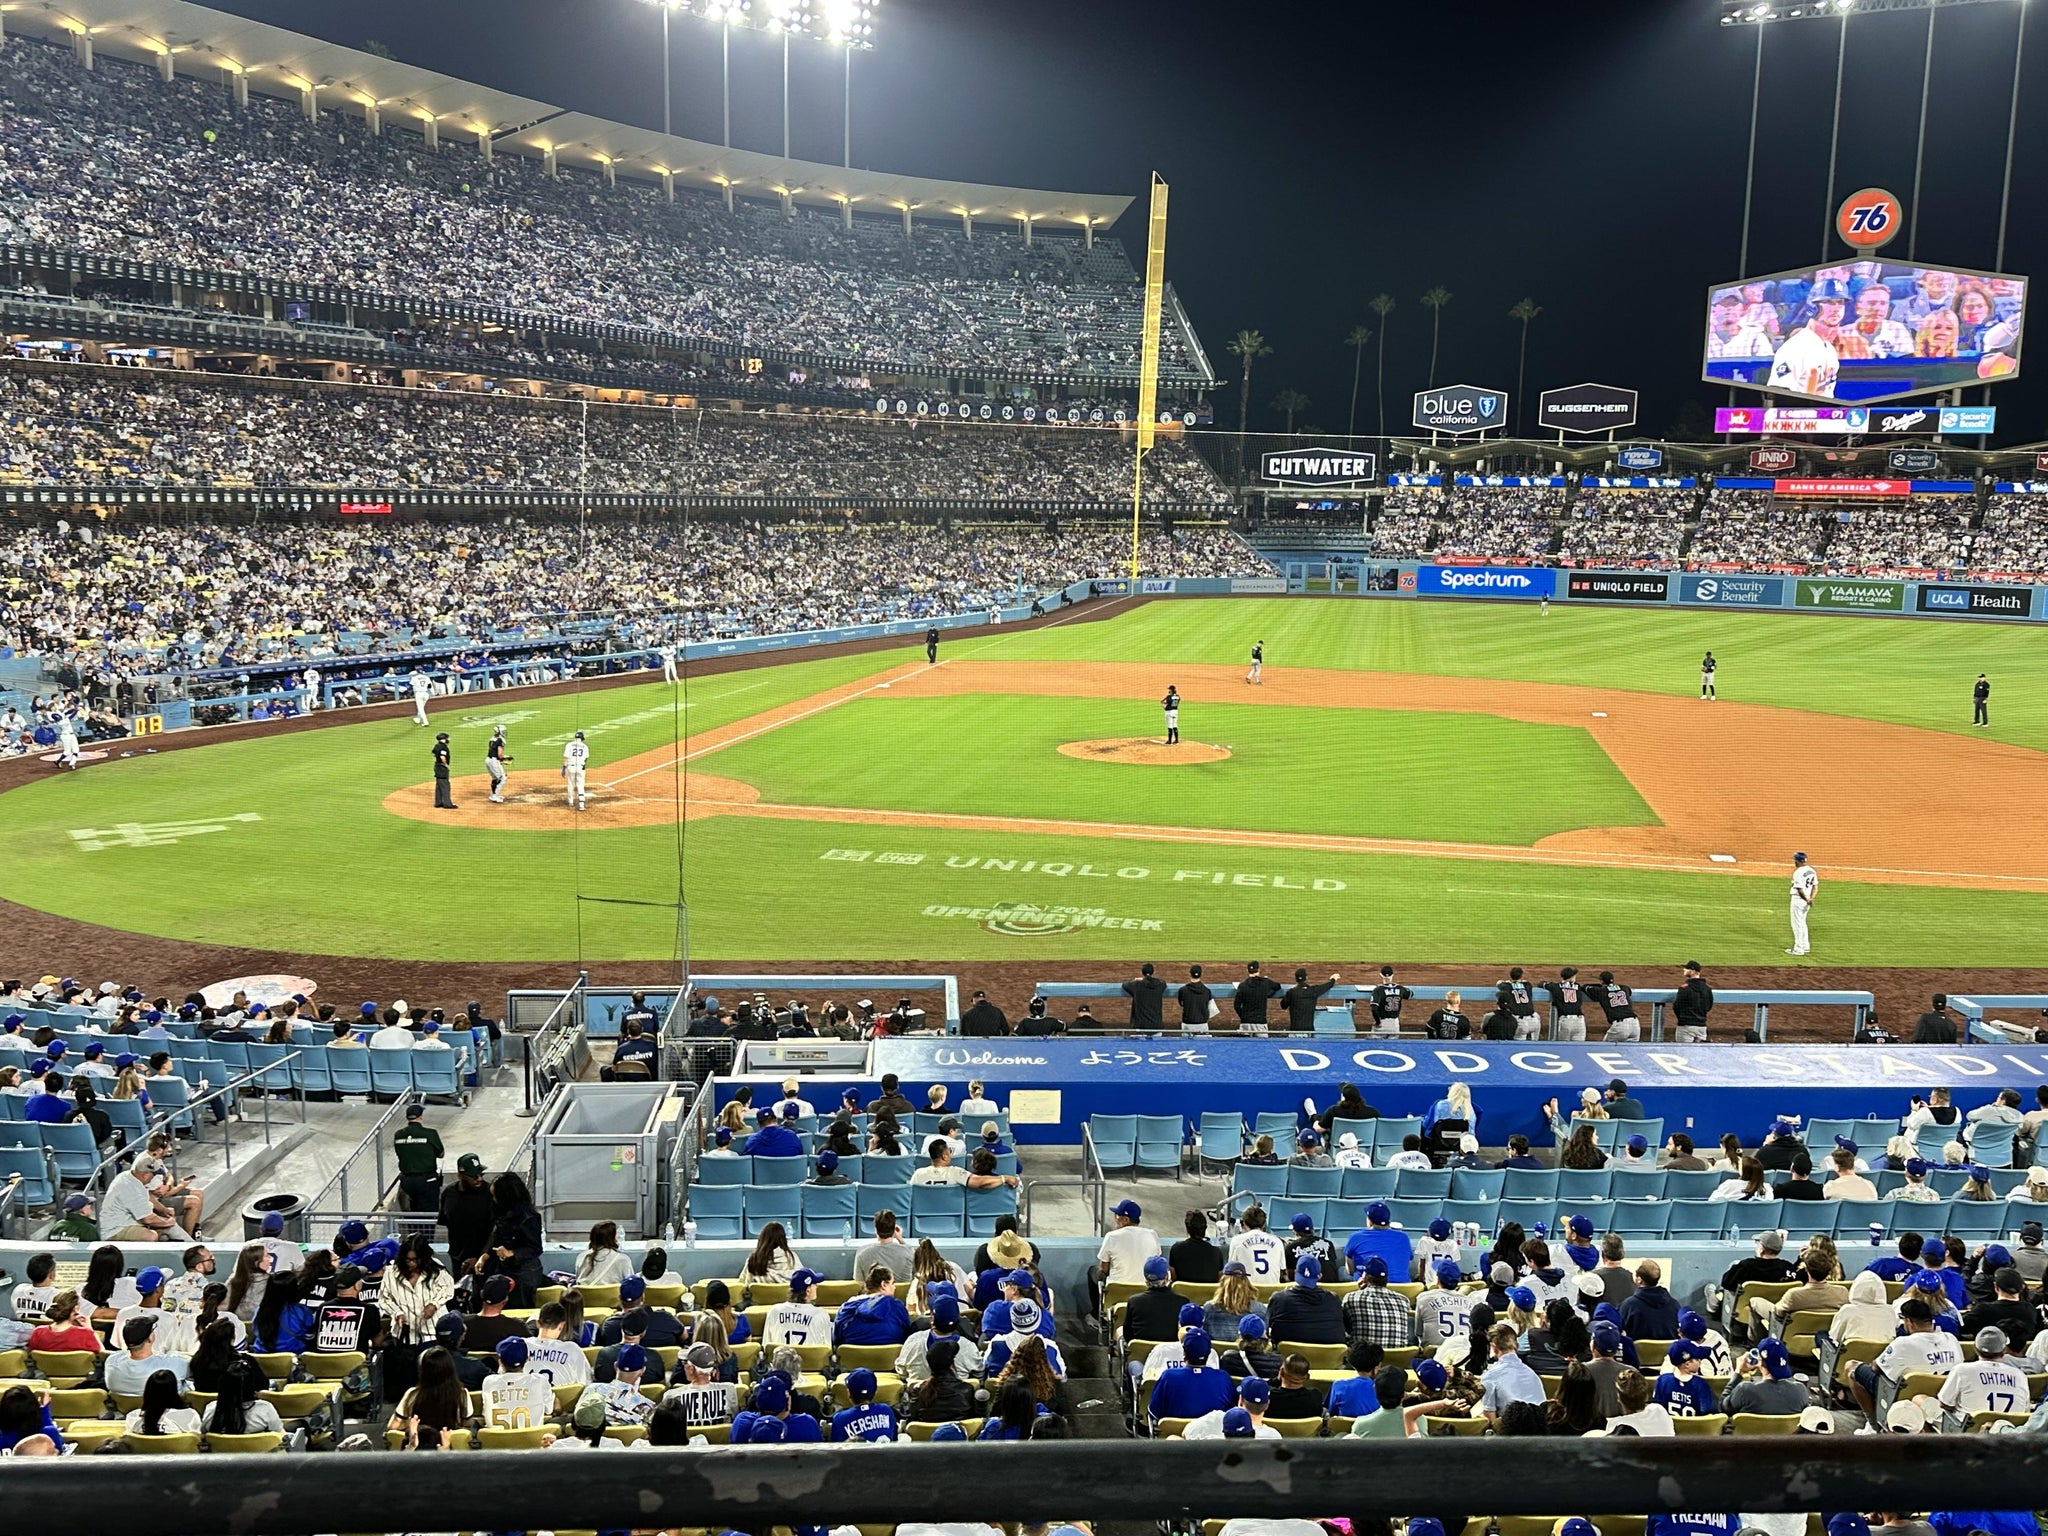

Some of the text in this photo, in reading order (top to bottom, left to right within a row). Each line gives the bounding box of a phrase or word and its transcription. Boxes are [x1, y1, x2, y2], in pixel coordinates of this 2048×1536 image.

[1848, 202, 1890, 233] 76
[1423, 395, 1472, 414] blue
[1548, 404, 1628, 413] GUGGENHEIM
[1430, 415, 1478, 424] california
[1881, 410, 1926, 431] Dodgers
[1959, 420, 1987, 428] Benefit
[1960, 412, 1991, 421] Security
[1624, 451, 1649, 459] TOYO
[1627, 458, 1655, 466] TIRES
[1758, 452, 1788, 464] JINRO
[1907, 454, 1932, 462] Security
[1269, 458, 1366, 476] CUTWATER
[1401, 576, 1415, 586] 76
[1440, 569, 1525, 589] Spectrum
[1721, 580, 1766, 593] Security
[1145, 583, 1163, 592] ANA
[1593, 582, 1631, 592] UNIQLO
[1633, 583, 1664, 593] FIELD
[1721, 592, 1759, 602] Benefit
[1931, 593, 2021, 609] UCLA Health
[572, 748, 583, 757] 23
[944, 855, 1152, 880] UNIQLO
[1173, 869, 1347, 892] FIELD
[921, 904, 1165, 932] OPENING WEEK
[1512, 989, 1529, 1003] 13
[1562, 988, 1577, 1003] 10
[1608, 991, 1628, 1007] 22
[626, 1012, 653, 1020] SECURITY
[622, 1051, 653, 1060] SECURITY
[934, 1048, 1048, 1065] Welcome
[1080, 1050, 1208, 1066] ようこそ
[1279, 1049, 2048, 1077] DODGER STADI
[1242, 1237, 1277, 1249] FREEMAN
[1253, 1250, 1269, 1275] 5
[779, 1312, 812, 1327] OHTANI
[1438, 1311, 1470, 1338] 55
[784, 1330, 807, 1345] 17
[529, 1349, 568, 1365] MAMOTO
[1926, 1351, 1954, 1365] SMITH
[1979, 1372, 2016, 1388] OHTANI
[491, 1389, 529, 1404] BETTS
[1671, 1391, 1692, 1404] BETTS
[1987, 1392, 2014, 1412] 17
[681, 1389, 727, 1420] WE RULE
[492, 1407, 531, 1429] 50
[844, 1414, 890, 1436] KERSHAW
[1671, 1513, 1727, 1529] FREEMAN
